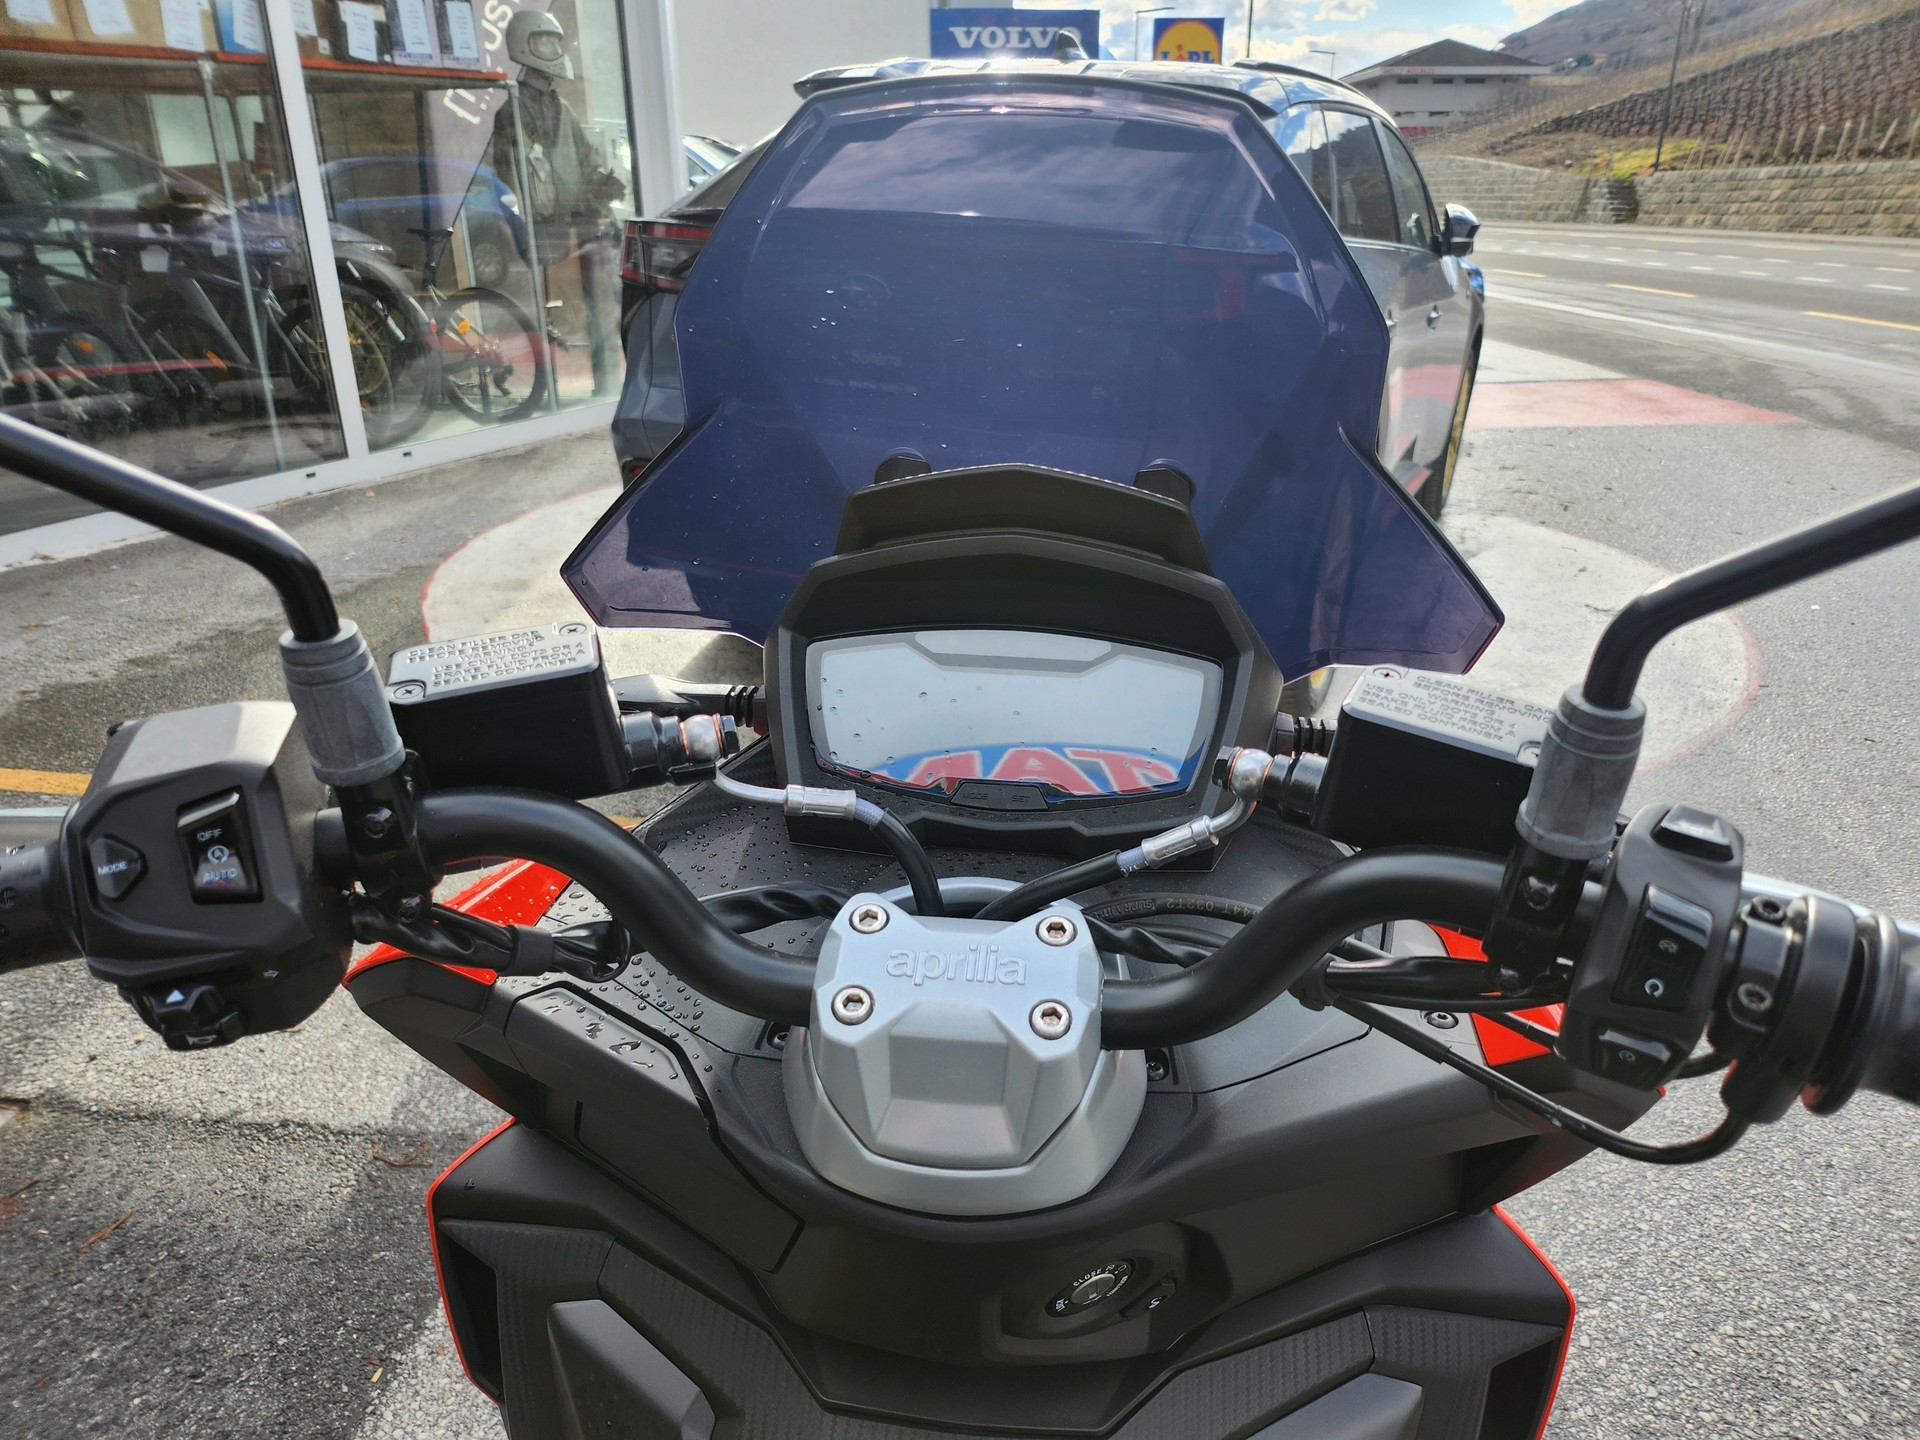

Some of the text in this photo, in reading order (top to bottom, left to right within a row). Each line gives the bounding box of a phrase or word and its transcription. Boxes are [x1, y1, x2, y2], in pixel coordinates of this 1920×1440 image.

[406, 633, 545, 664] BEFORE REMOVING
[408, 630, 539, 657] CLEAN FILLER CAP
[432, 663, 463, 673] USE
[466, 655, 506, 668] ONLY
[432, 666, 481, 681] BRAKE
[486, 659, 528, 672] FLUID
[531, 650, 572, 662] FROM
[432, 656, 577, 687] SEALED CONTAINER
[1366, 683, 1394, 695] USE
[1398, 692, 1437, 706] ONLY
[1482, 715, 1504, 727] OR
[1412, 681, 1471, 700] BEFORE
[1416, 675, 1463, 691] CLEAN
[1466, 688, 1516, 707] FILLER
[1358, 696, 1504, 742] SEALED CONTAINER
[1362, 689, 1409, 708] BRAKE
[1413, 703, 1455, 721] FLUID
[1457, 716, 1503, 734] FROM
[196, 828, 223, 842] OFF
[97, 860, 128, 876] MODE
[202, 867, 238, 884] AUTO
[885, 943, 1029, 986] aprilia
[1072, 1267, 1103, 1287] CLOSE
